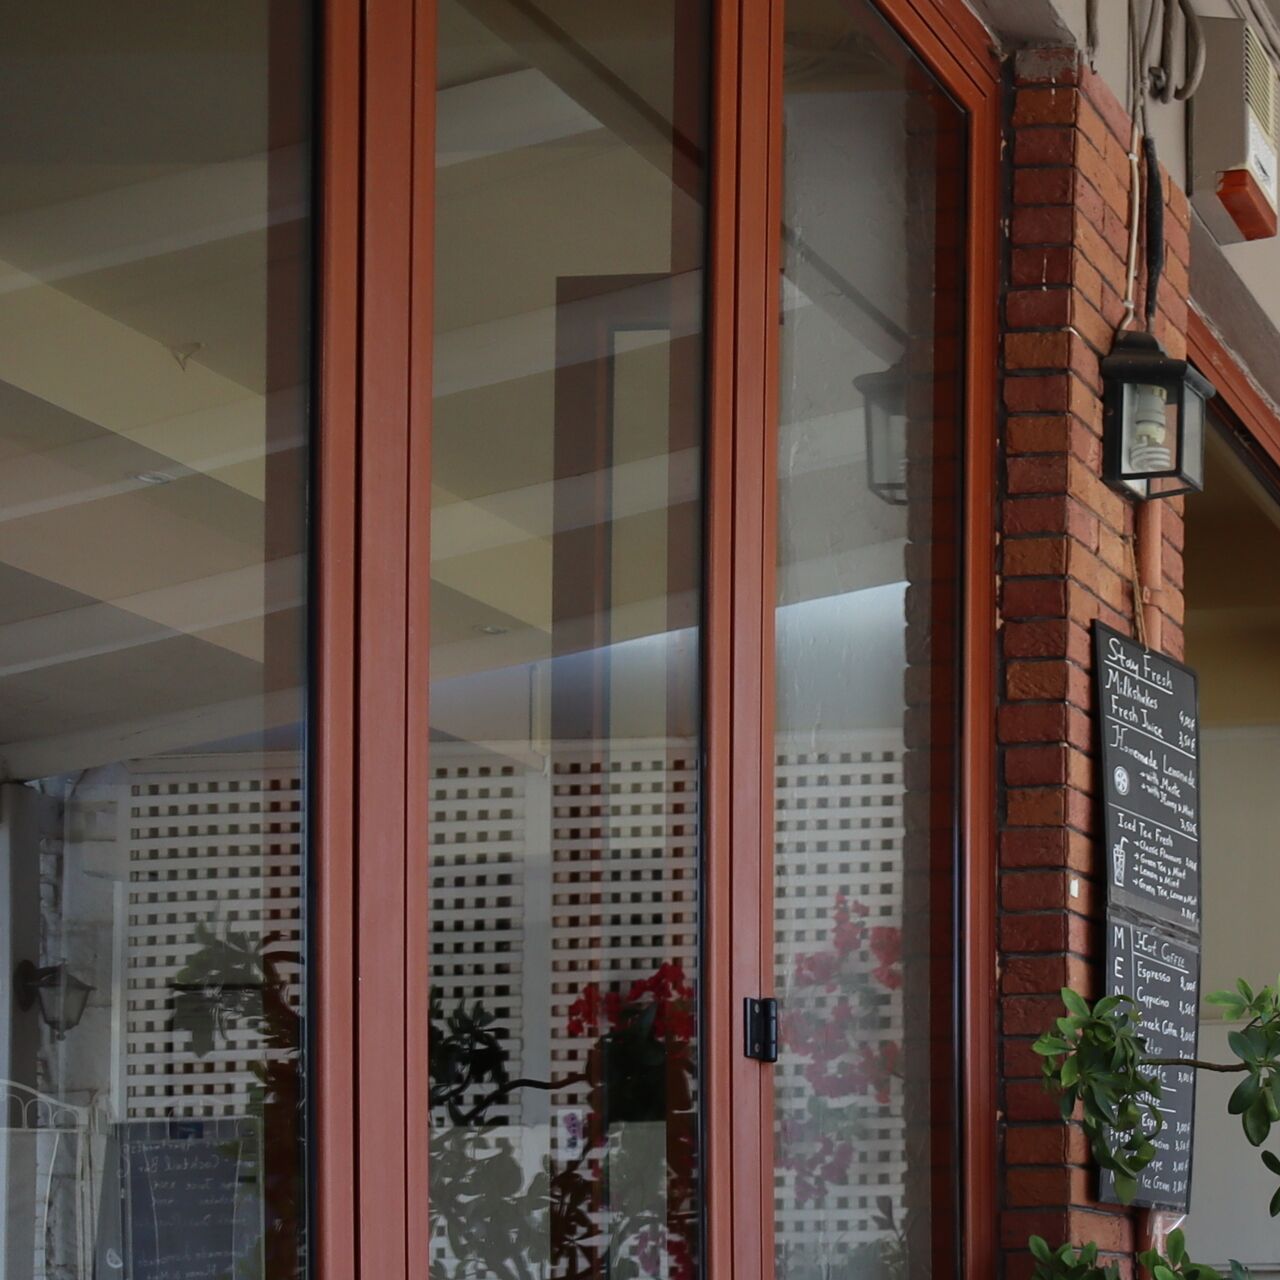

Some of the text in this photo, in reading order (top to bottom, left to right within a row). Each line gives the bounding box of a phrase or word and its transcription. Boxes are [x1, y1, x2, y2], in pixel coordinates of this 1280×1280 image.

[1107, 637, 1173, 689] Stay Fresh
[1105, 669, 1158, 709] Milkshakes
[1111, 695, 1138, 723] Fresh
[1140, 708, 1164, 739] Juice
[1110, 724, 1196, 788] Homemade Lemonade
[1118, 812, 1173, 847] Iced Tea Fresh
[1157, 861, 1166, 873] Tea
[1135, 931, 1157, 956] Hot
[1137, 961, 1171, 984] Espresso
